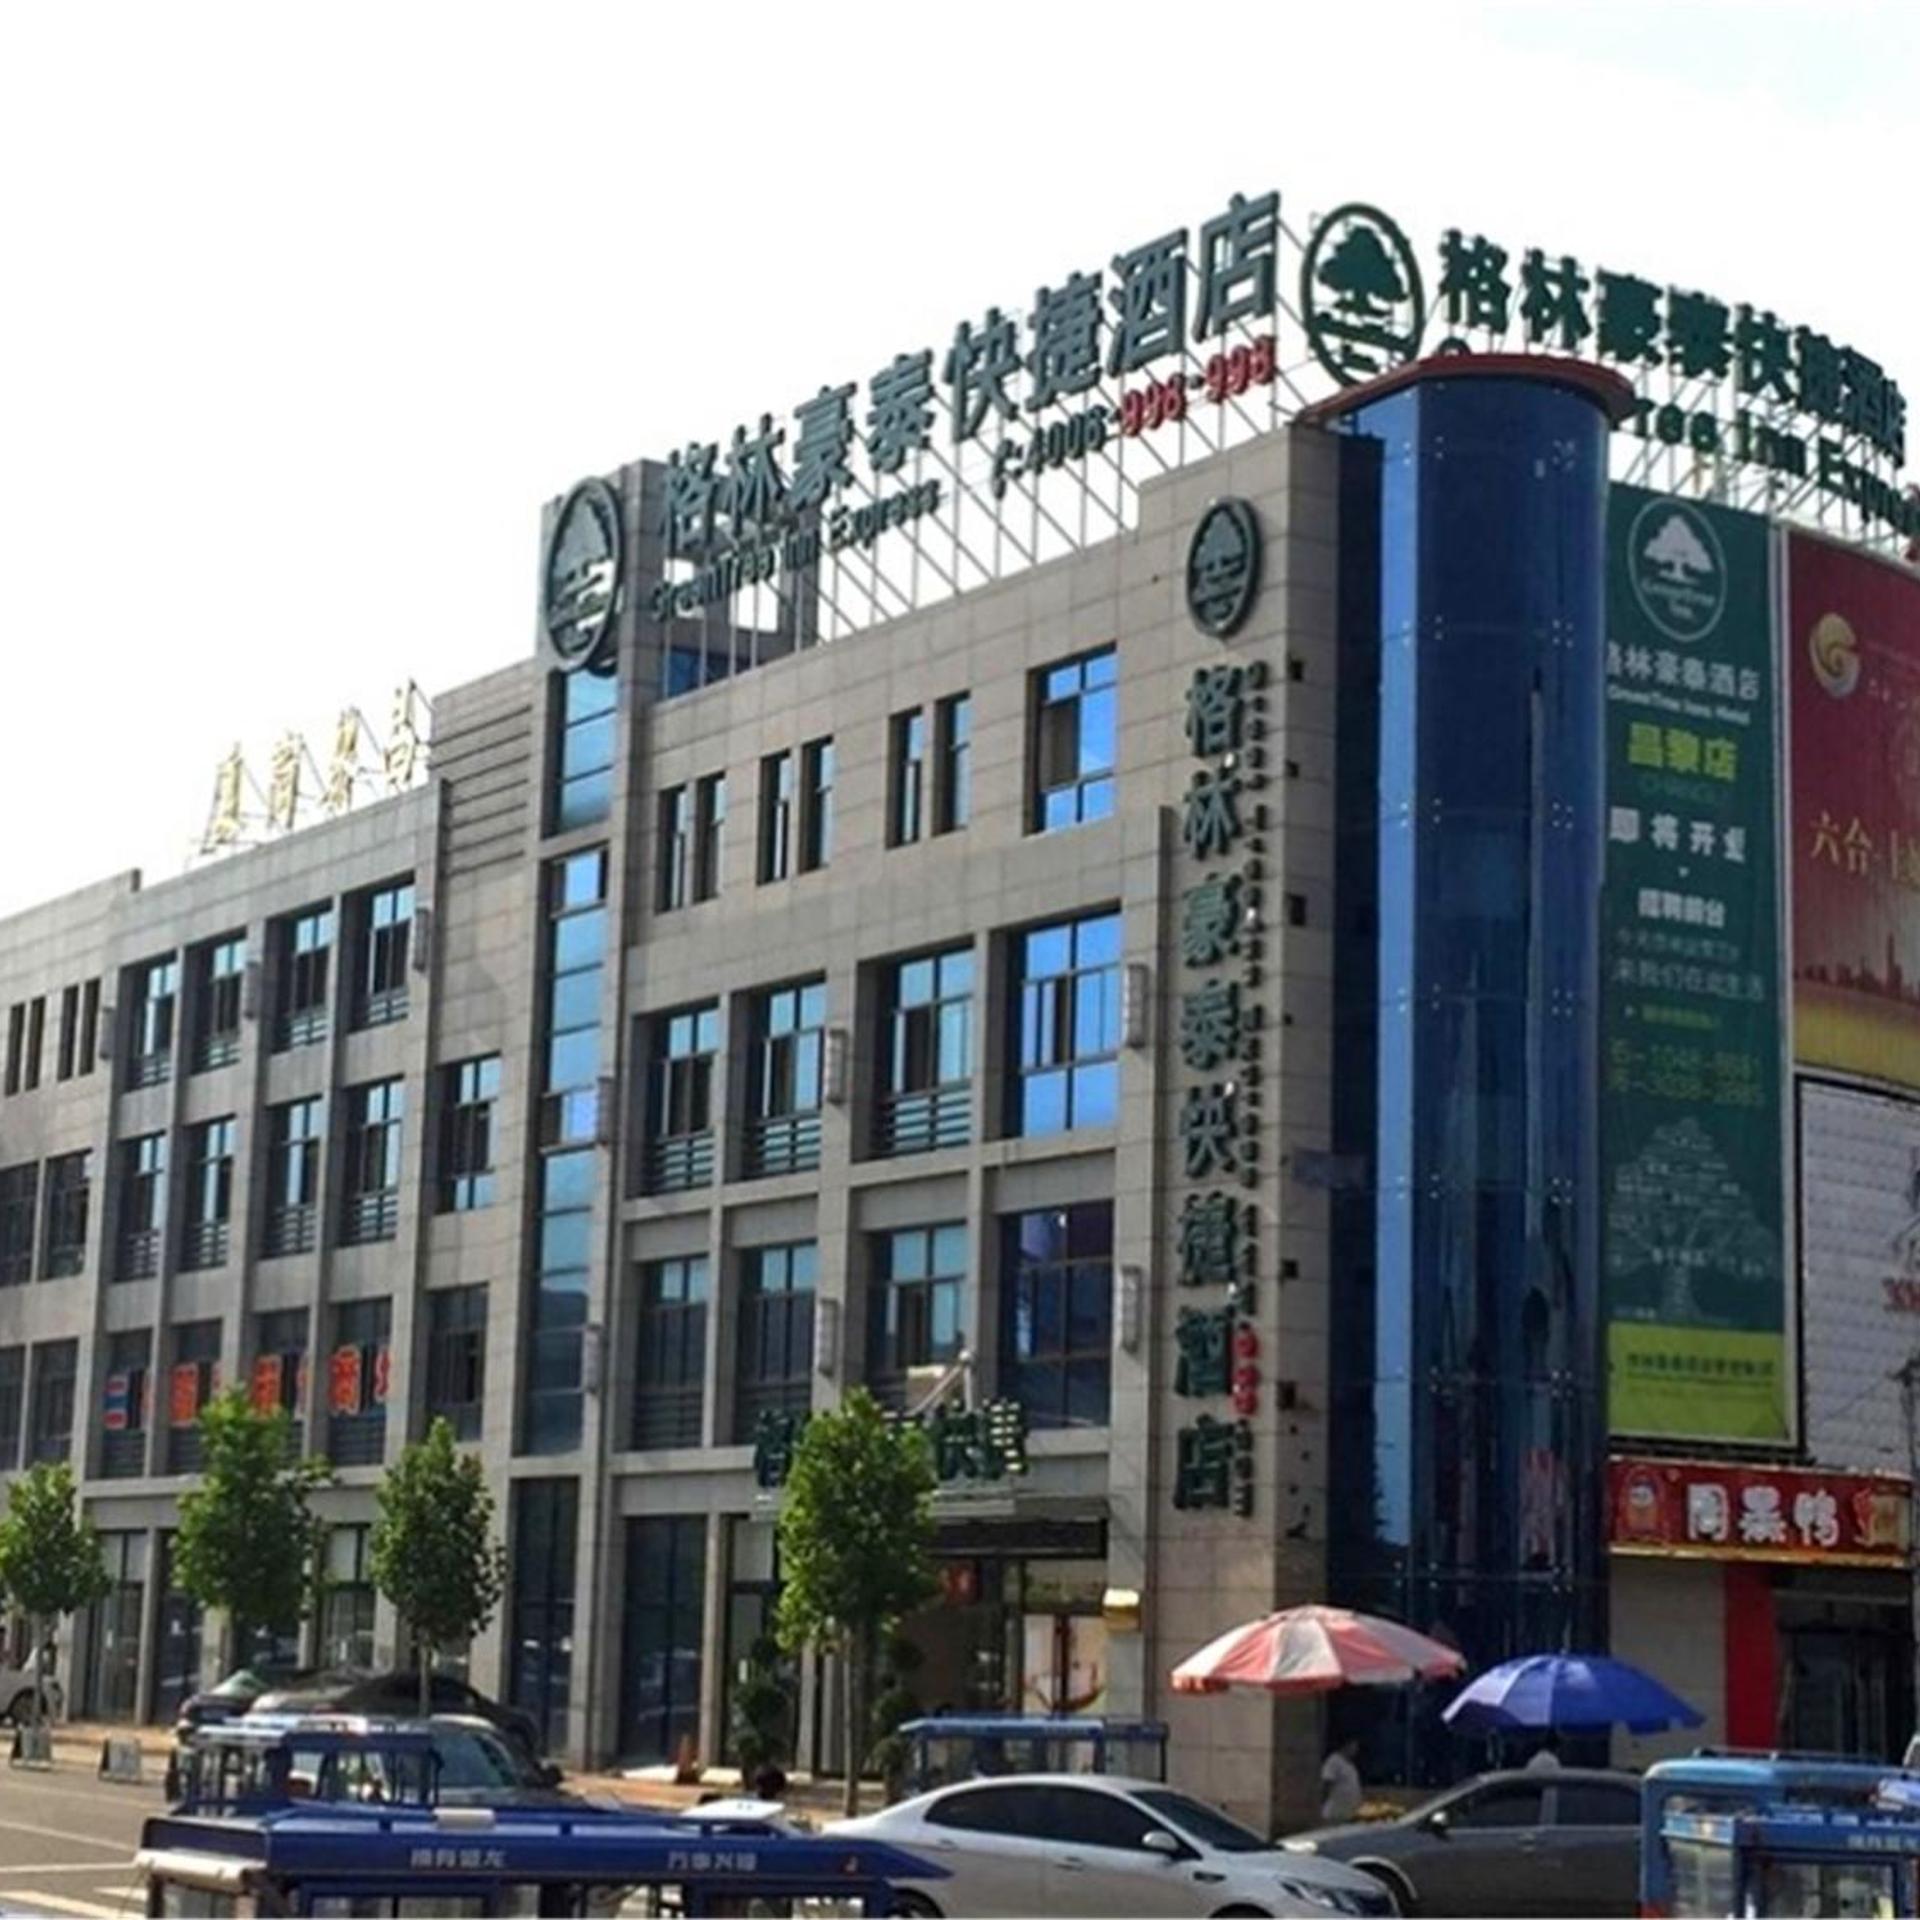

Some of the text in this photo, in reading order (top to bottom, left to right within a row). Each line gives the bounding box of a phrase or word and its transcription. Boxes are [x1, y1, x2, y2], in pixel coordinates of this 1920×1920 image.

[660, 190, 1281, 550] 格林豪泰快捷酒店
[1172, 664, 1246, 1513] 格林豪泰快捷酒店
